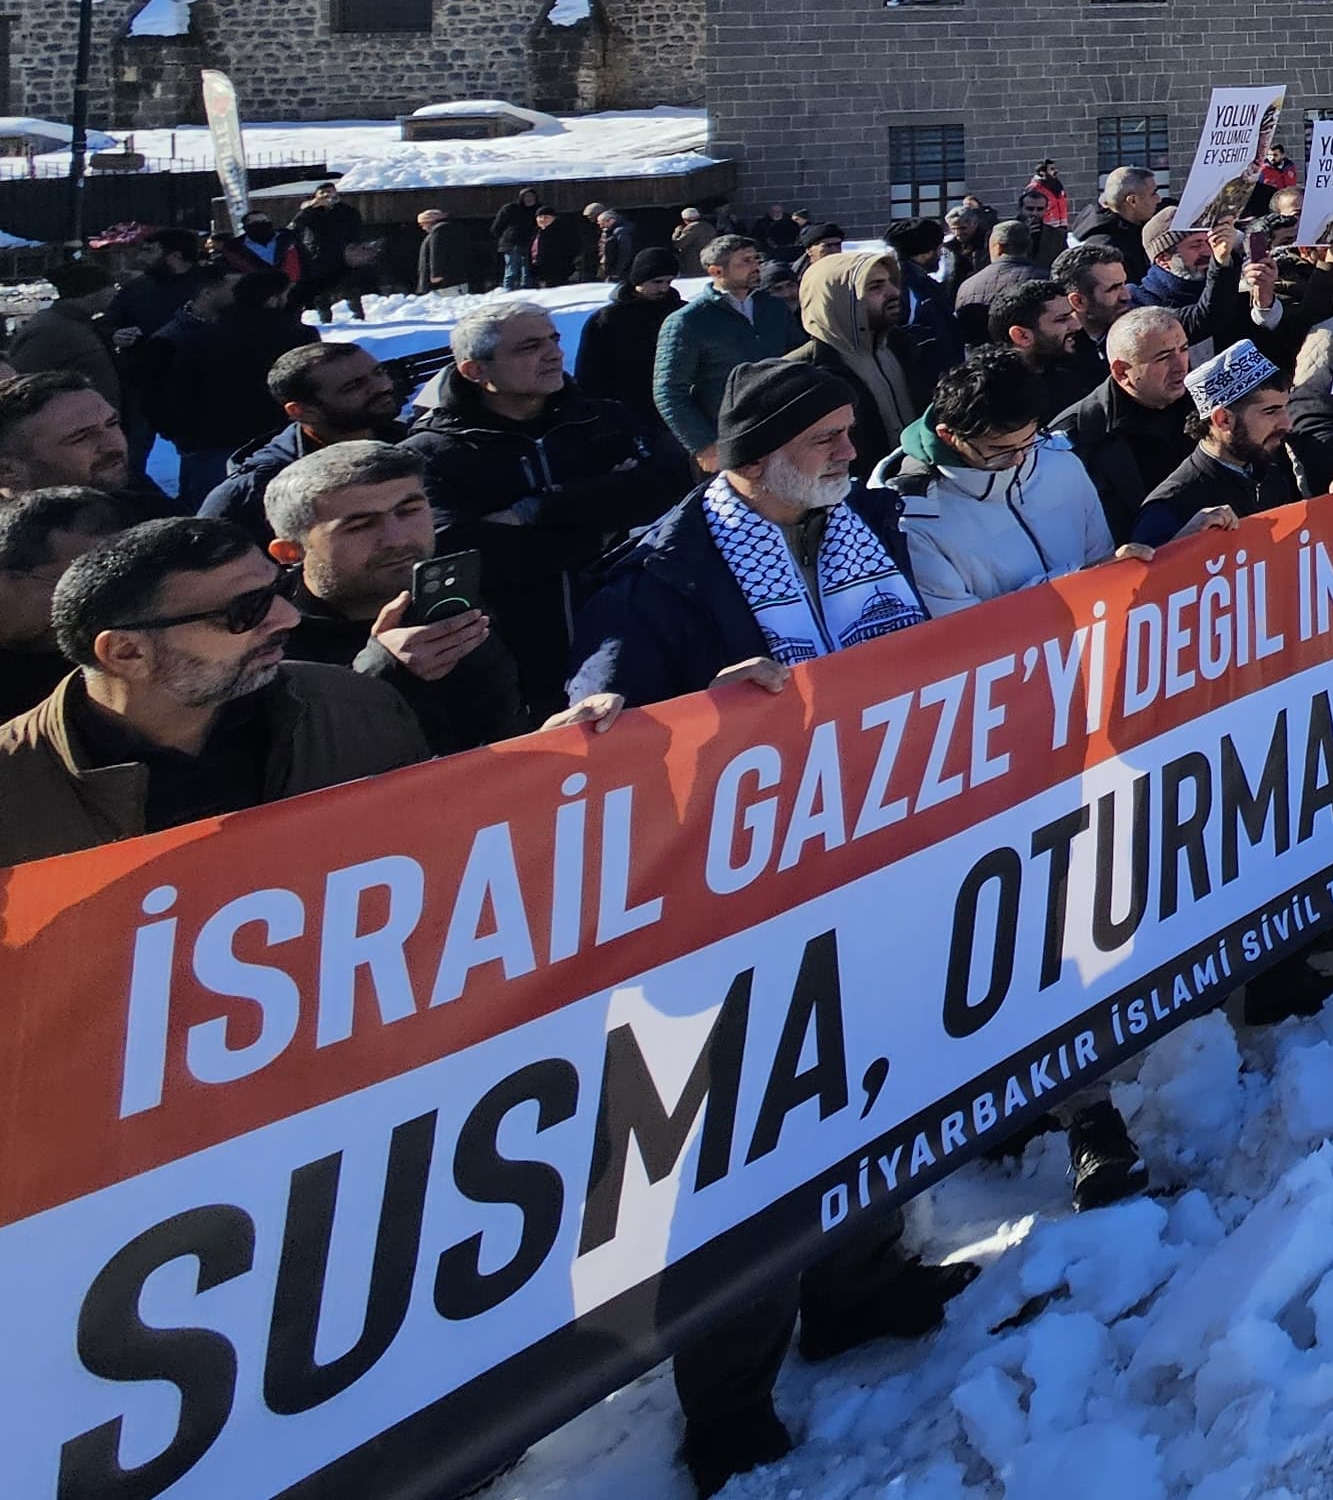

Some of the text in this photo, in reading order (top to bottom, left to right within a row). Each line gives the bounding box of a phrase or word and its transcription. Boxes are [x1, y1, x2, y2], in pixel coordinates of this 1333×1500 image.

[1215, 103, 1260, 129] YOLUN
[1210, 128, 1253, 146] YOLUMUZ
[1203, 147, 1248, 167] EY ŞEHİT!
[1316, 174, 1330, 188] EY
[119, 770, 664, 1121] İSRAİL
[704, 601, 1107, 896] GAZZE'Yİ
[1123, 550, 1285, 718] DEĞİL
[820, 1031, 1099, 1234] DİYARBAKIR
[1112, 937, 1233, 1048] İSLAMİ
[1242, 894, 1321, 964] SİVİL
[58, 929, 891, 1500] SUSMA,
